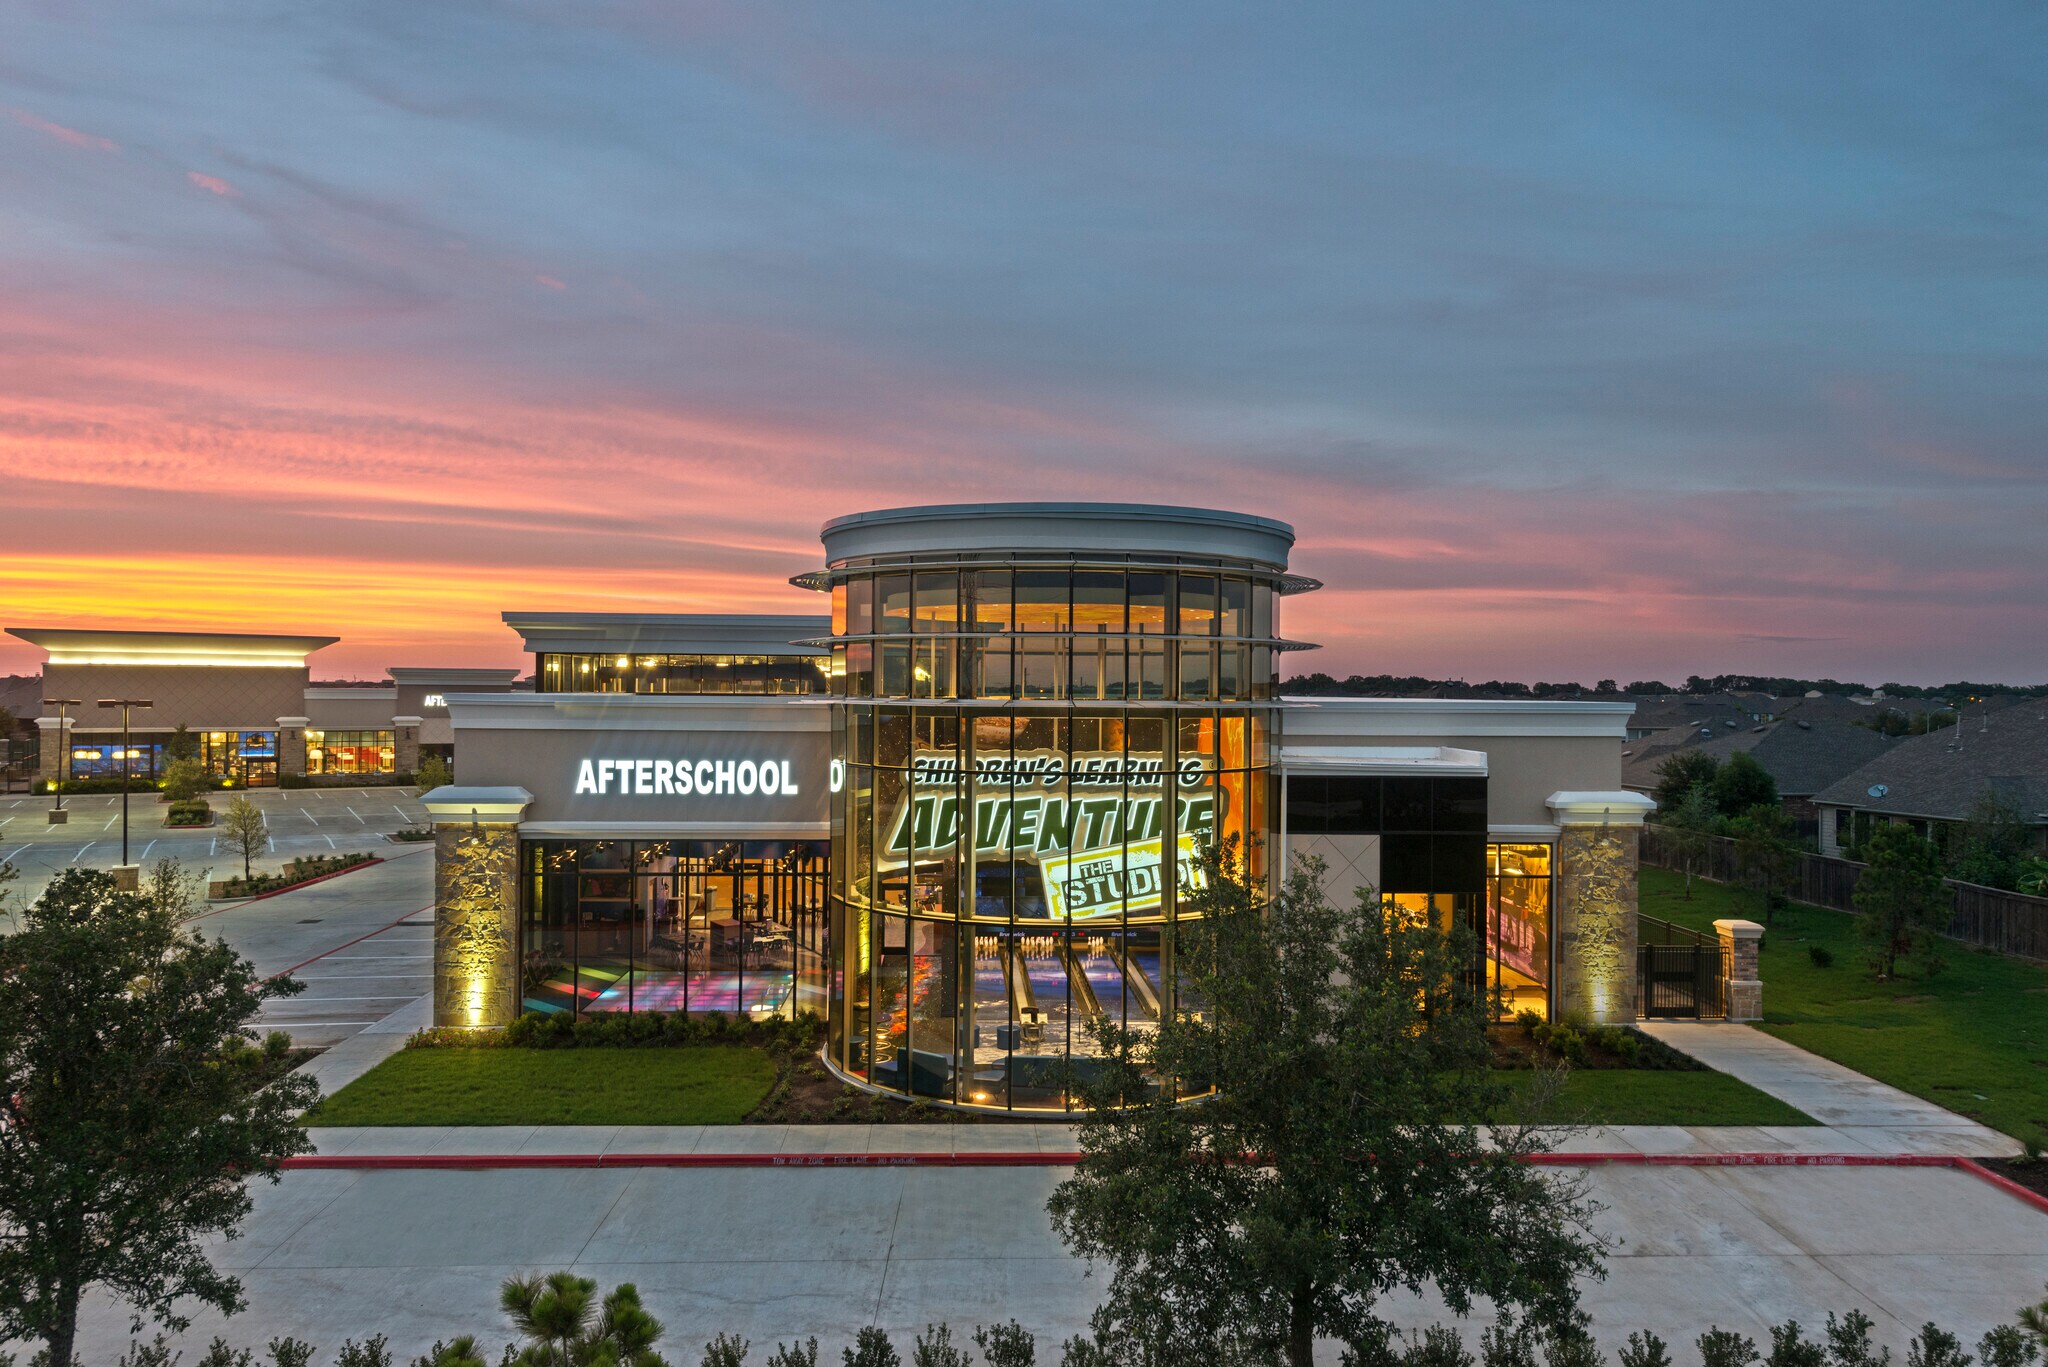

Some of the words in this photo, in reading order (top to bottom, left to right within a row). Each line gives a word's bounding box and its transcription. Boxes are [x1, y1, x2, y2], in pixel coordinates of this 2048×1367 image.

[575, 759, 798, 795] AFTERSCHOOL
[1071, 758, 1203, 786] LEARNIG
[1080, 860, 1112, 879] THE
[808, 1157, 825, 1165] ZONE
[834, 1156, 848, 1164] FIRE
[852, 1156, 869, 1164] LANE
[878, 1157, 887, 1165] NO
[890, 1157, 916, 1165] PARKING
[1740, 1156, 1757, 1165] ZONE
[1764, 1156, 1778, 1165] FIRE
[1781, 1156, 1798, 1165] LANE
[1808, 1157, 1817, 1165] NO
[1820, 1156, 1845, 1165] PARKING
